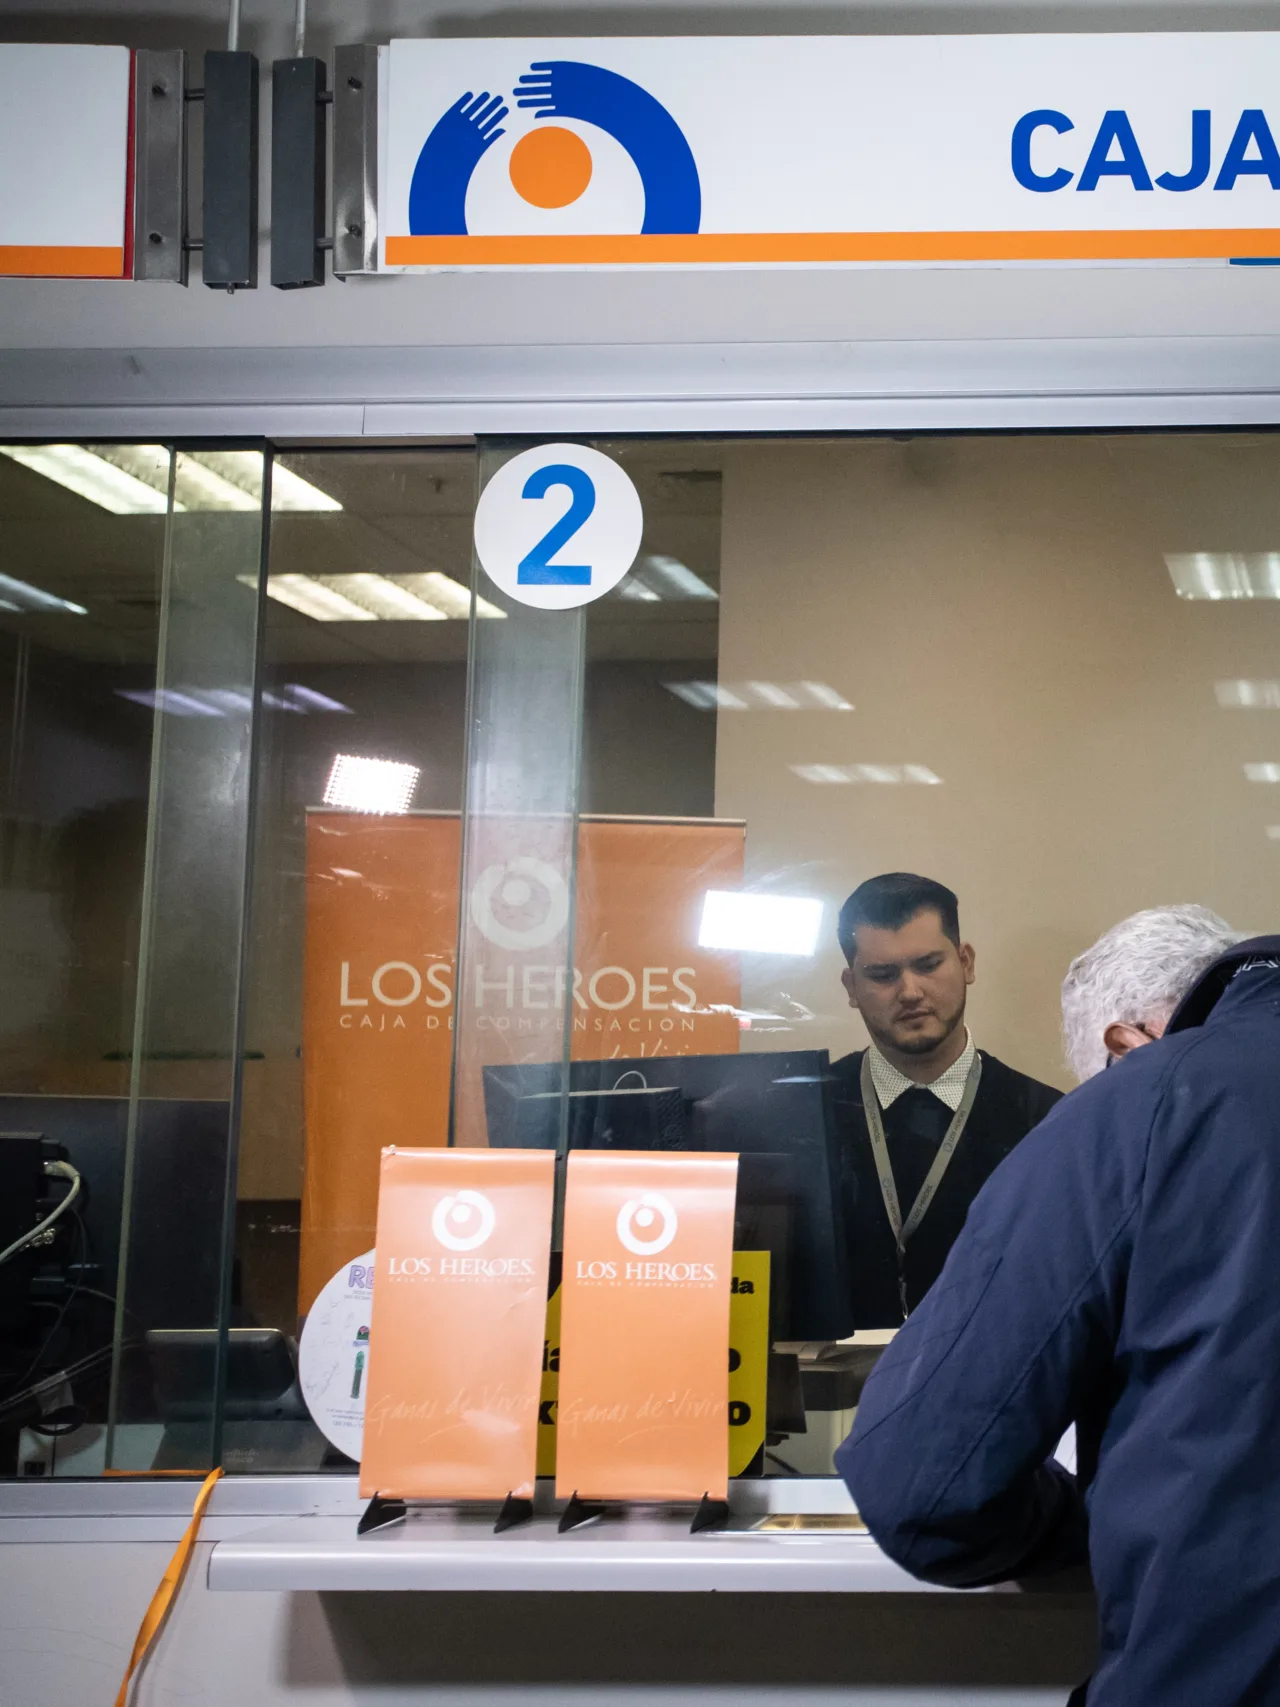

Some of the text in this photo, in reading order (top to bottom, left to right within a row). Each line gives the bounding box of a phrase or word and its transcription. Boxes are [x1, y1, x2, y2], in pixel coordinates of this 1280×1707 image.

[517, 464, 596, 586] 2
[340, 961, 698, 1011] LOS HEROES
[340, 1014, 695, 1033] CAJA DE COMPENSACION
[388, 1257, 432, 1275] LOS
[576, 1261, 617, 1279] LOS
